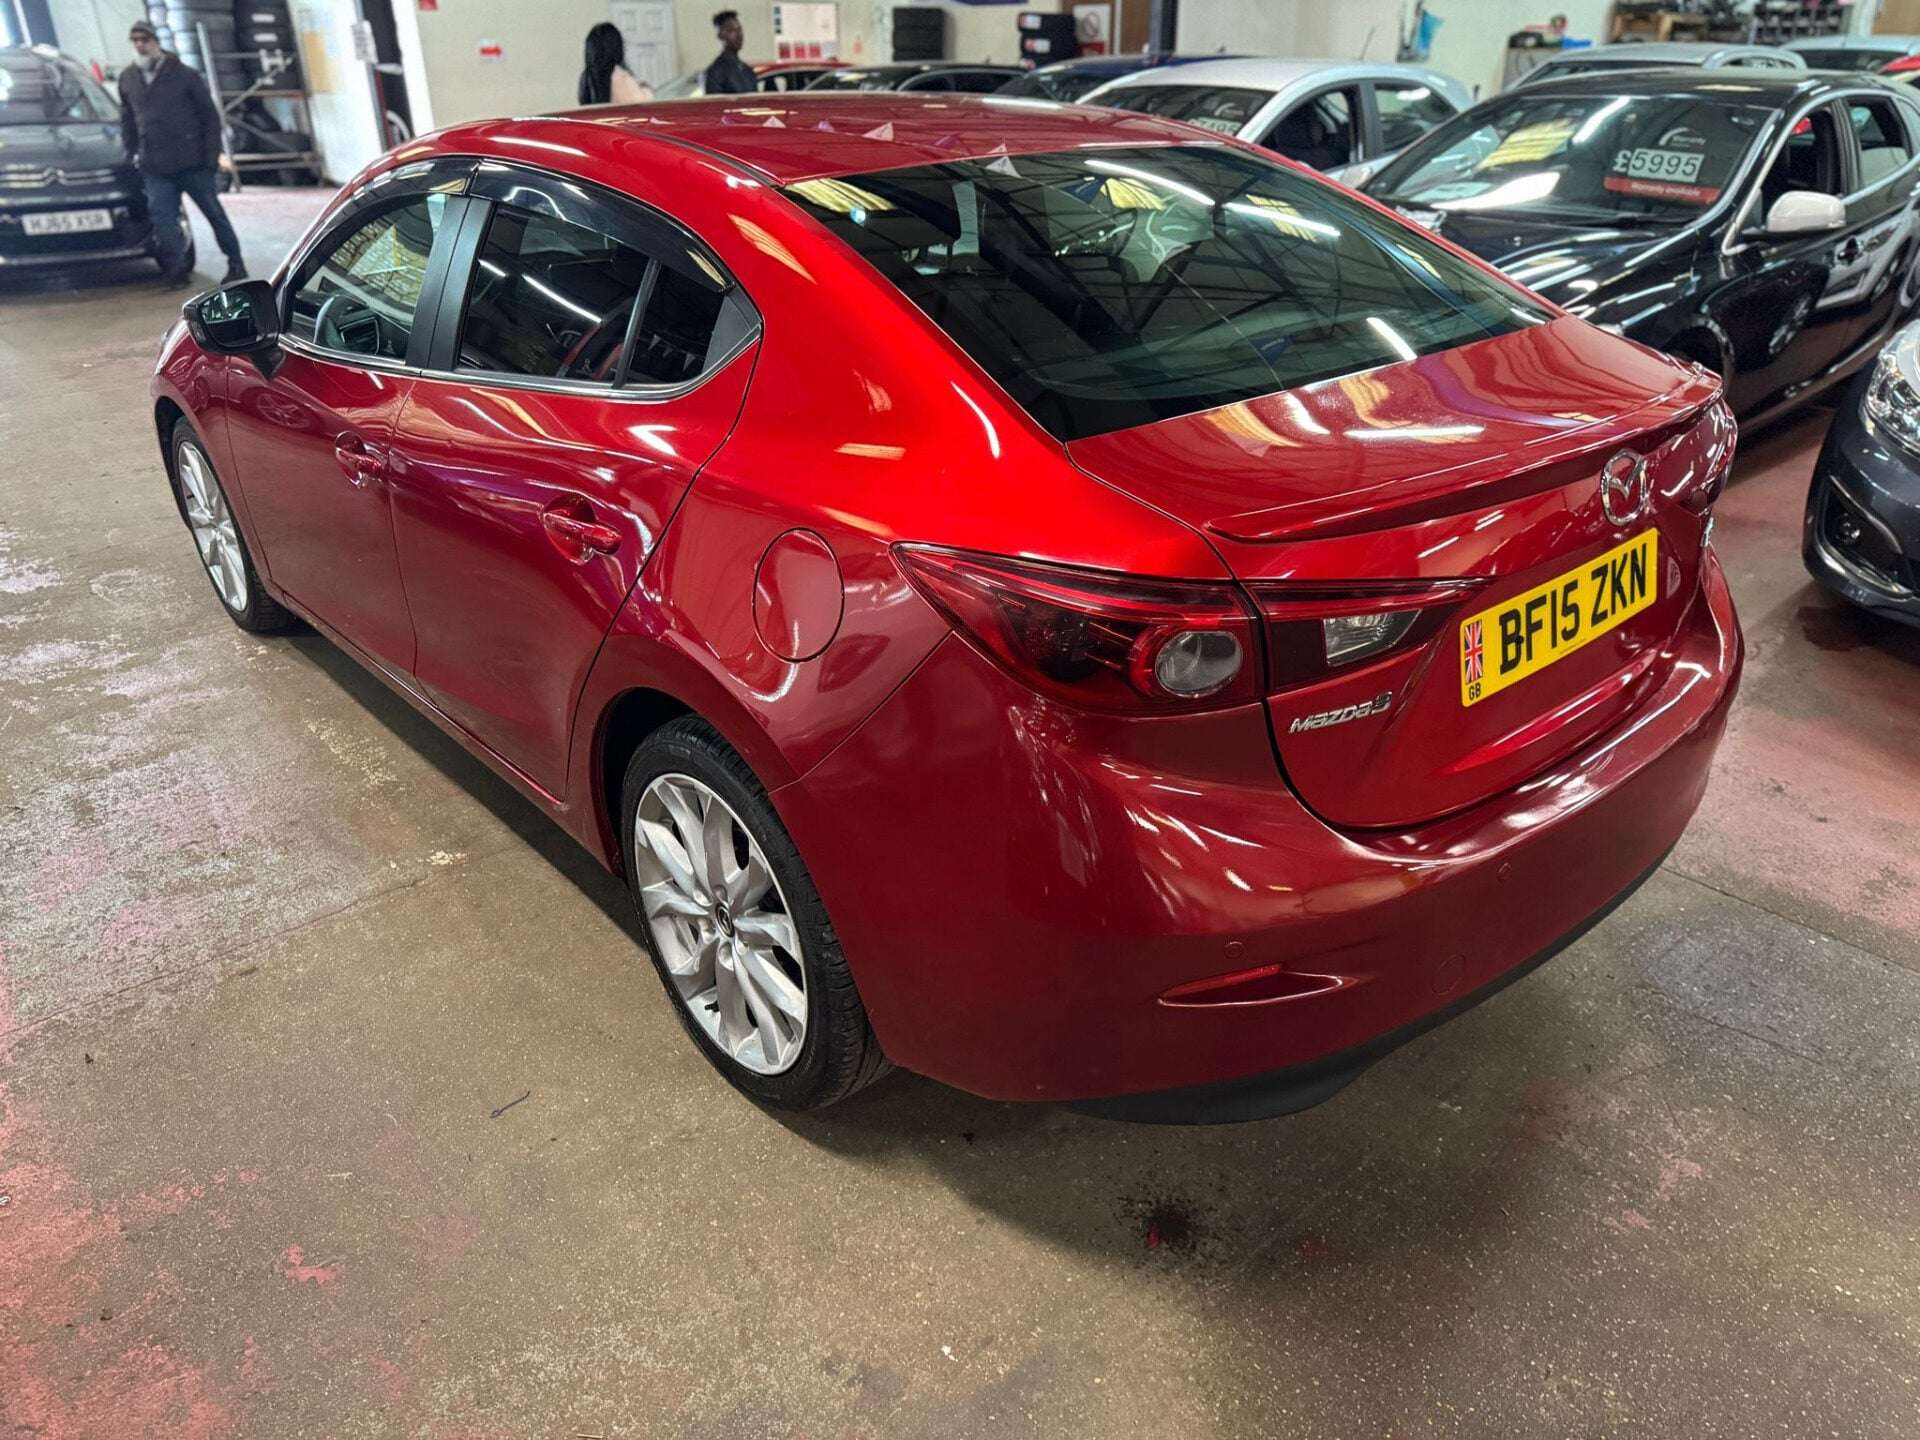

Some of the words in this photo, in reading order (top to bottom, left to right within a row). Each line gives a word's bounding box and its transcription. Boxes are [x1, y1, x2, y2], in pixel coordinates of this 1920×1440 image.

[1612, 149, 1700, 177] £5995
[1499, 578, 1581, 676] BF15
[1590, 542, 1648, 628] ZKN
[1468, 682, 1482, 701] GB
